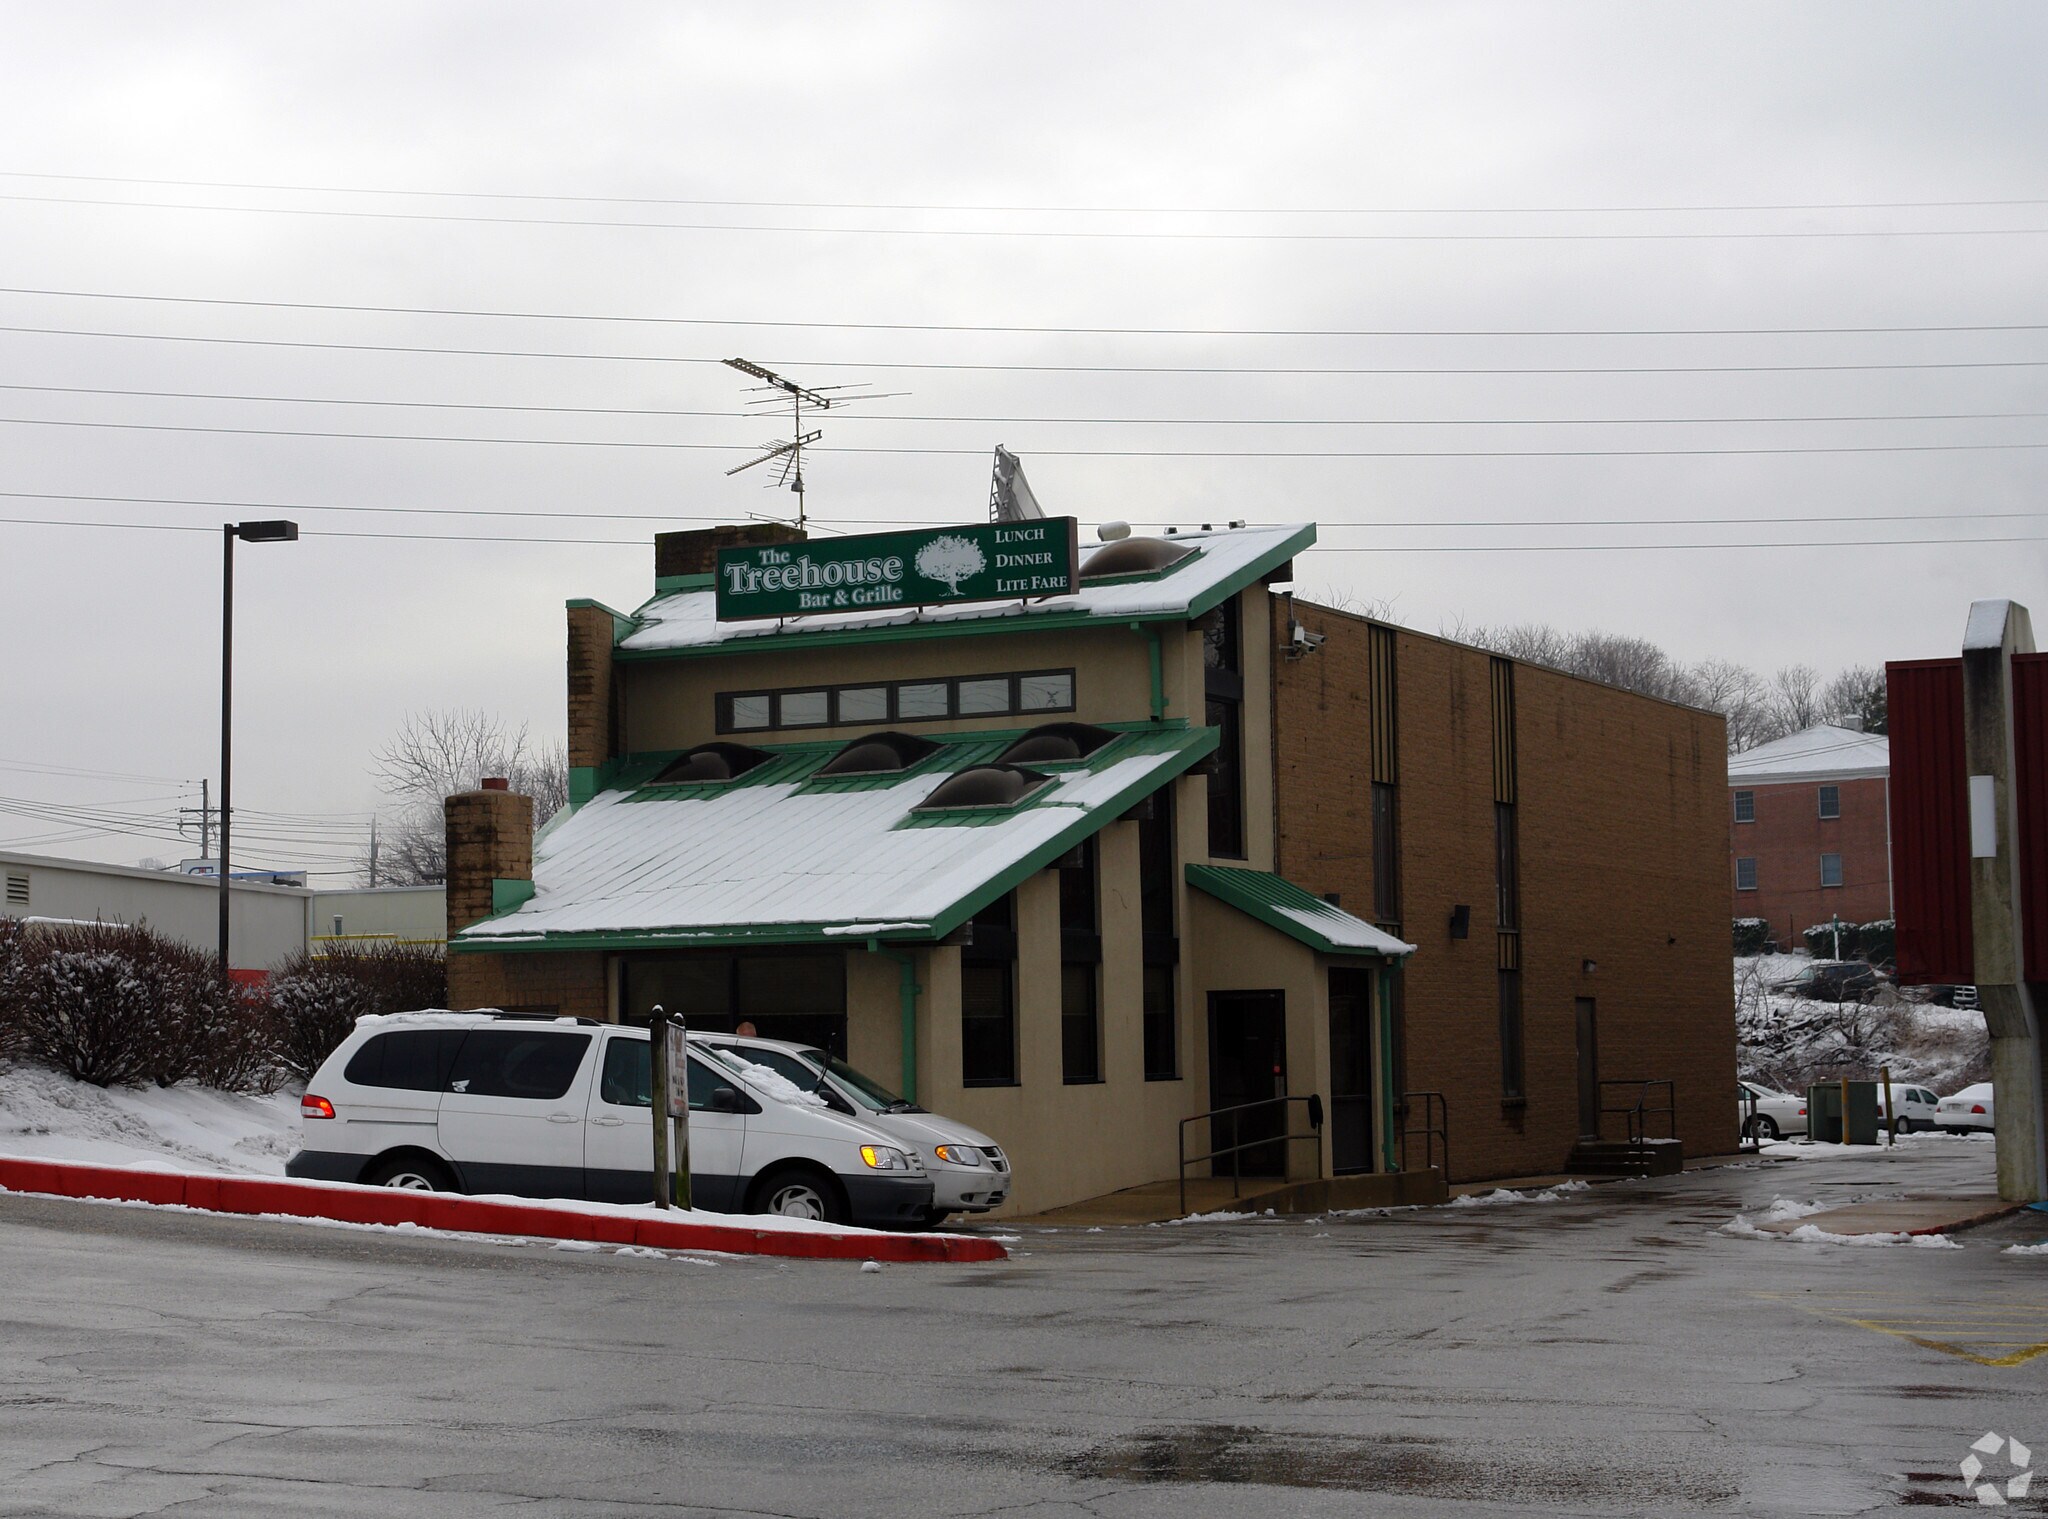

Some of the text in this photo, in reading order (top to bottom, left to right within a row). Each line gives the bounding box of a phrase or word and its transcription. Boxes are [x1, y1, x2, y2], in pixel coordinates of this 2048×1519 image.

[995, 528, 1045, 543] LUNCH
[758, 548, 790, 565] The
[995, 552, 1053, 568] DINNER
[724, 555, 903, 595] Treehouse
[996, 575, 1068, 592] LITE FARE
[799, 584, 903, 608] Bar & Grille
